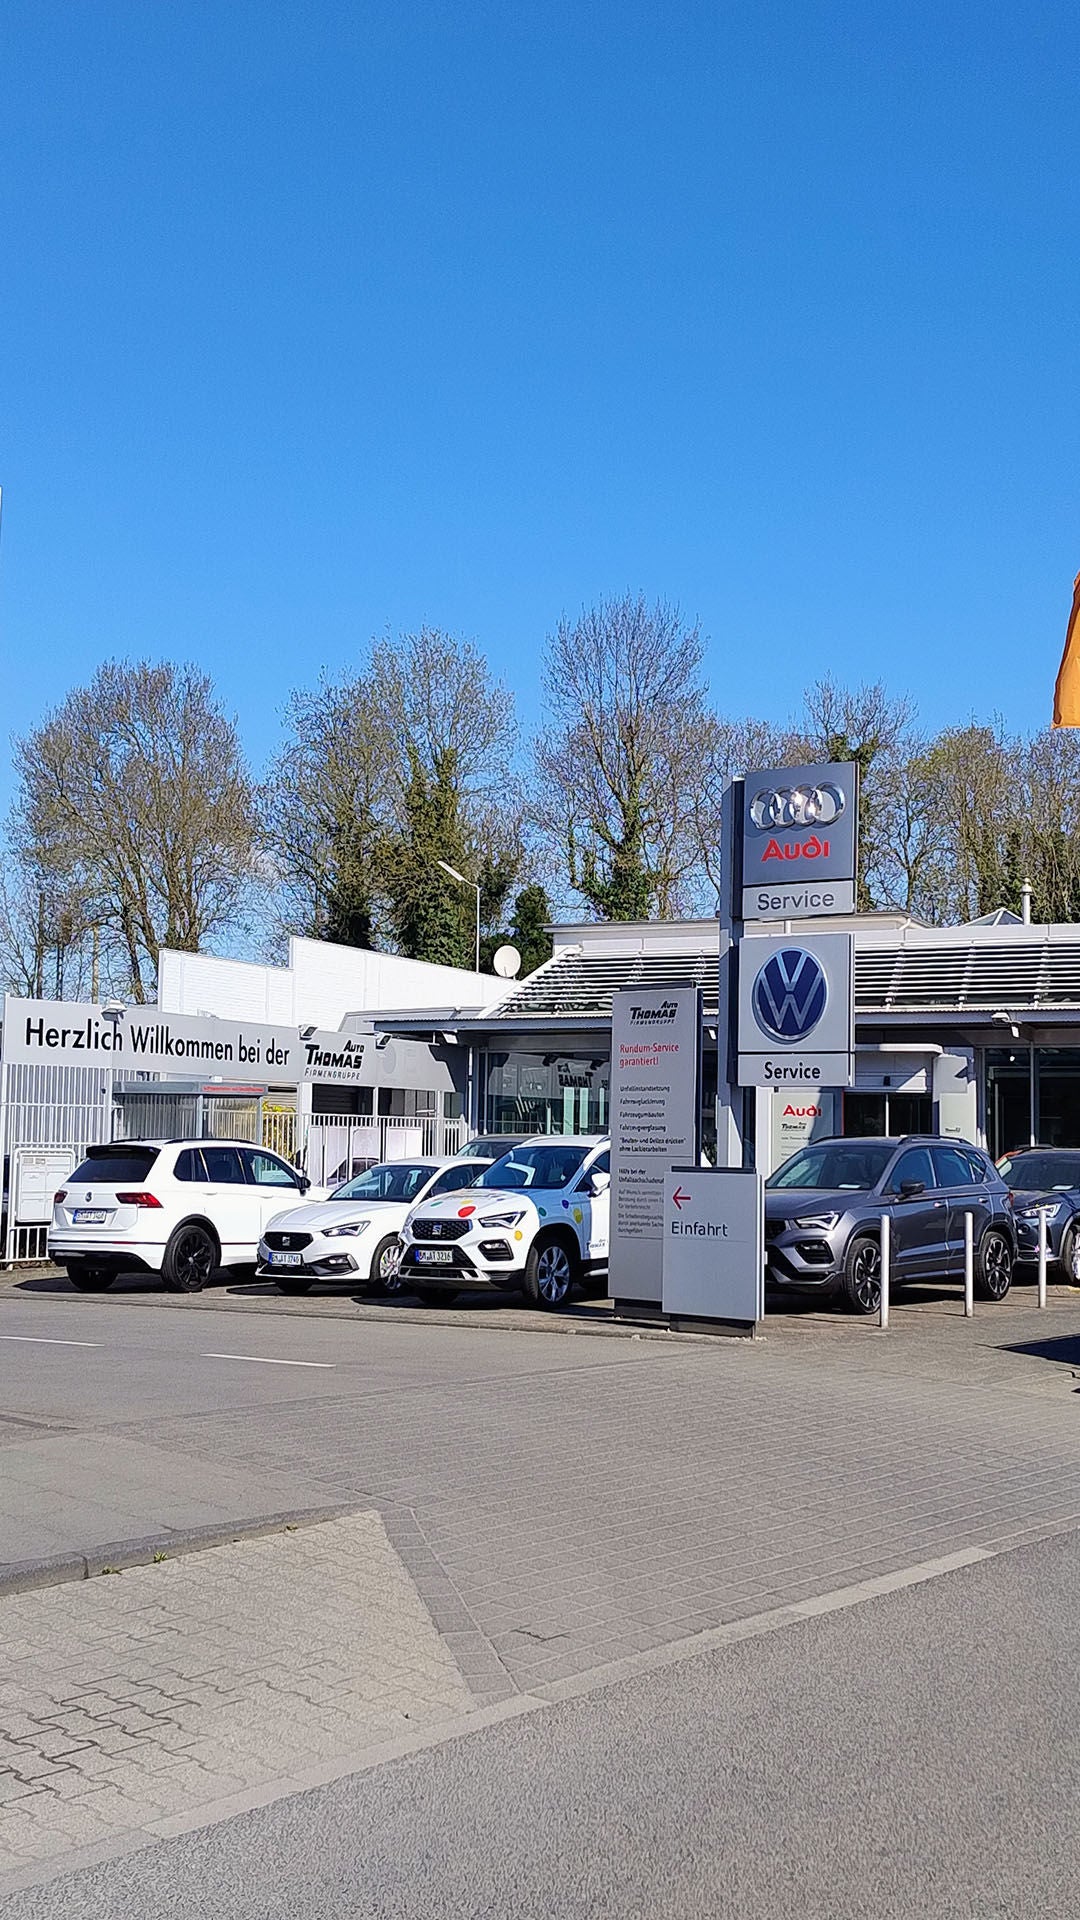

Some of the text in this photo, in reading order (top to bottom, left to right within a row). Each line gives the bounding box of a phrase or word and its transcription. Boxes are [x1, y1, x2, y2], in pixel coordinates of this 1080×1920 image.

[761, 836, 830, 862] Audi
[757, 890, 834, 911] Service
[630, 1006, 677, 1020] THOMAS
[25, 1017, 290, 1066] Herzlich Willkommen bei der
[343, 1039, 365, 1053] AUTO
[619, 1042, 680, 1054] Rundum-Service
[304, 1044, 363, 1070] THOMAS
[764, 1061, 821, 1080] Service
[782, 1104, 822, 1117] Audi
[671, 1221, 729, 1238] Einfahrt
